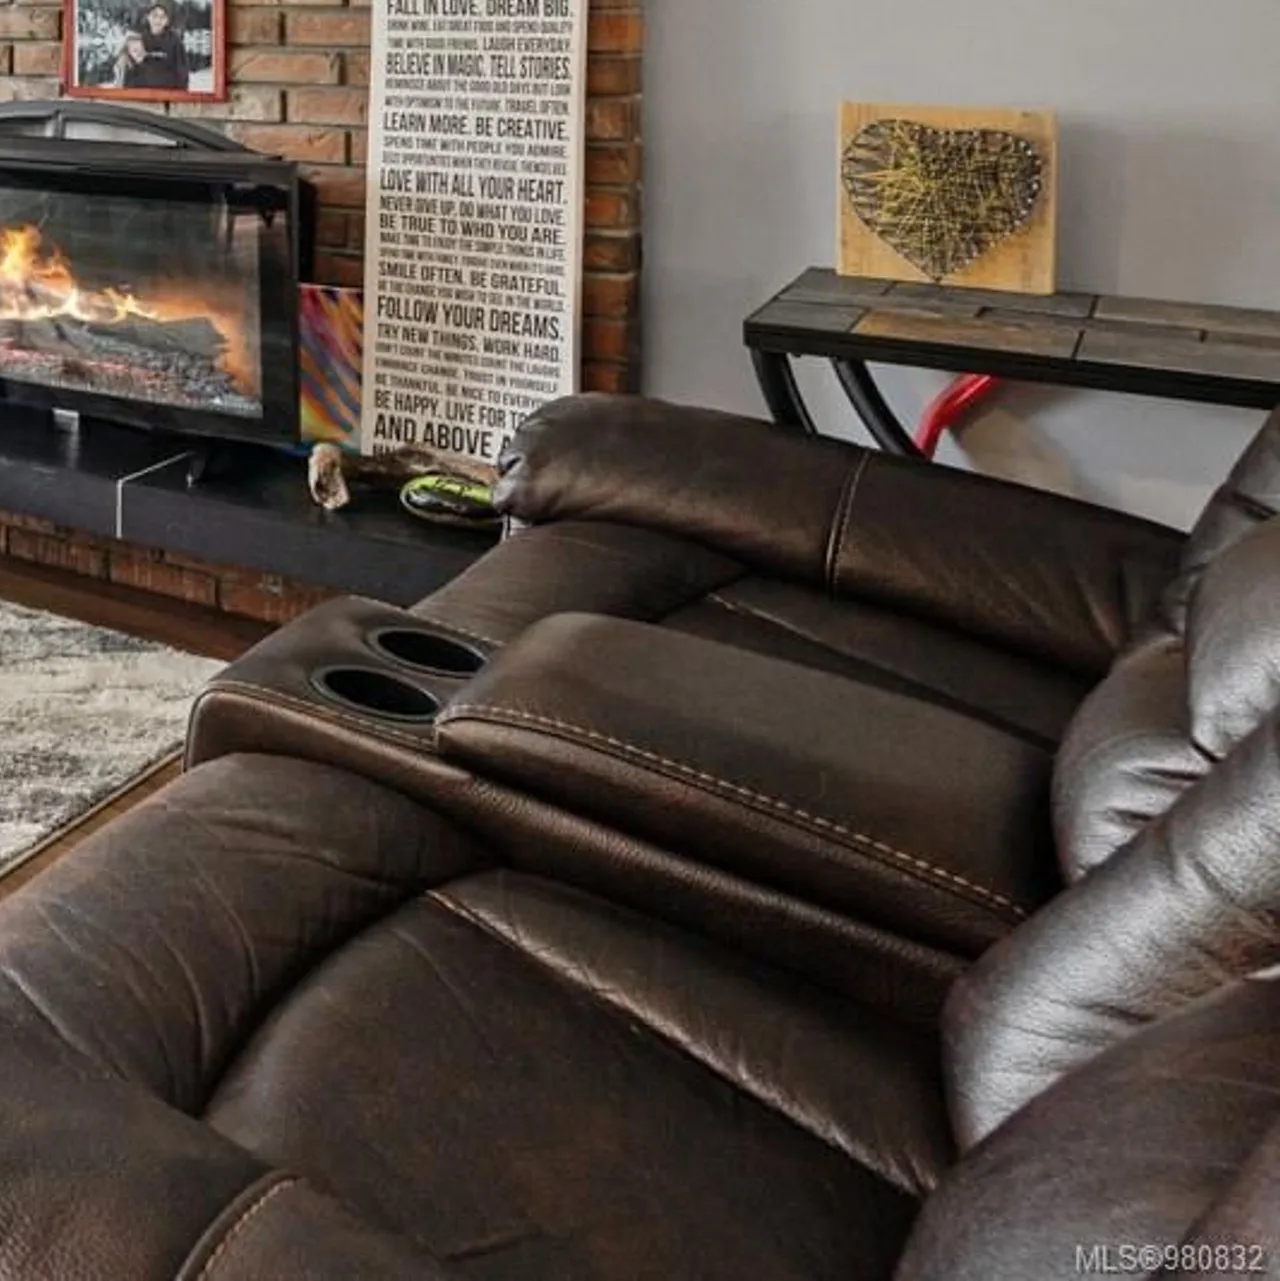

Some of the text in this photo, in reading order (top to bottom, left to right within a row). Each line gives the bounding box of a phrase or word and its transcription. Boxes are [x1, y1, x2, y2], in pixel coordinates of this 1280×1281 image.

[386, 51, 431, 76] BELIEVE
[433, 53, 444, 76] IN
[490, 54, 515, 79] TELL
[383, 111, 426, 133] LEARN
[476, 116, 493, 137] BE
[497, 117, 570, 141] CREATIVE.
[380, 168, 568, 205] LOVE WITH ALL YOUR HEART.
[380, 195, 412, 211] NEVER
[415, 198, 437, 214] GIVE
[459, 200, 474, 217] DO
[476, 203, 508, 221] WHAT
[510, 205, 532, 223] YOU
[379, 213, 396, 229] BE
[401, 215, 436, 233] TRUE
[439, 217, 457, 235] TO
[461, 221, 494, 238] WHO
[498, 223, 527, 242] YOU
[378, 261, 417, 279] SMILE
[470, 270, 487, 289] BE
[490, 273, 565, 297] GRATEFUL.
[377, 295, 564, 342] FOLLOW YOUR DREAMS.
[377, 323, 400, 339] TRY
[402, 327, 429, 344] NEW
[483, 336, 520, 357] WORK
[374, 388, 392, 410] BE
[394, 390, 442, 419] HAPPY.
[445, 399, 475, 424] LIVE
[478, 404, 506, 429] FOR
[373, 412, 416, 445] AND
[423, 420, 493, 459] ABOVE
